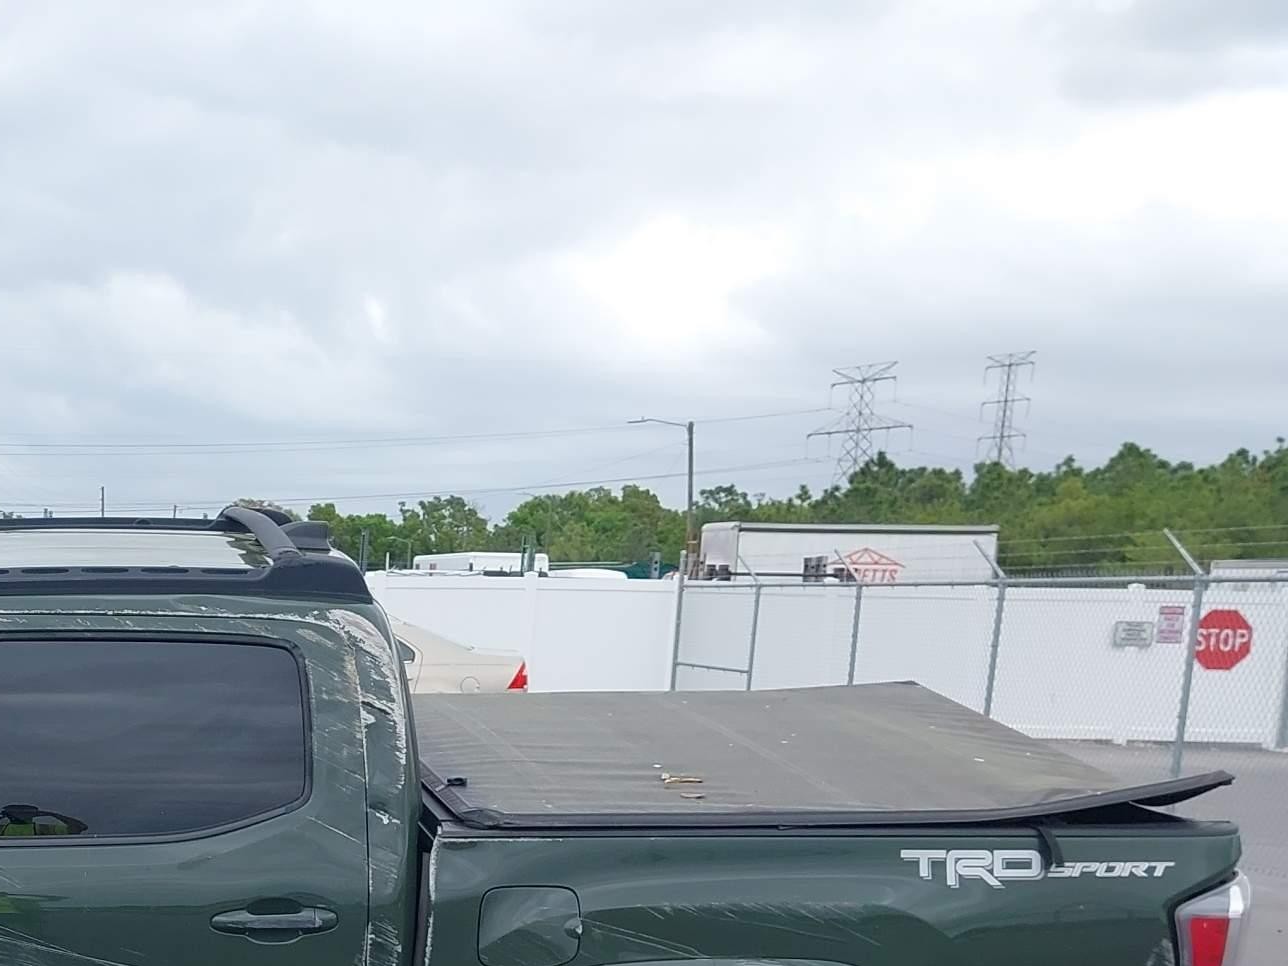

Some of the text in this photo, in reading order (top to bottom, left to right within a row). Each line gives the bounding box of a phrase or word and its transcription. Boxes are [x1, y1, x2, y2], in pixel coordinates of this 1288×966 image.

[1195, 628, 1249, 652] STOP
[900, 849, 1176, 888] TRD SPORT
